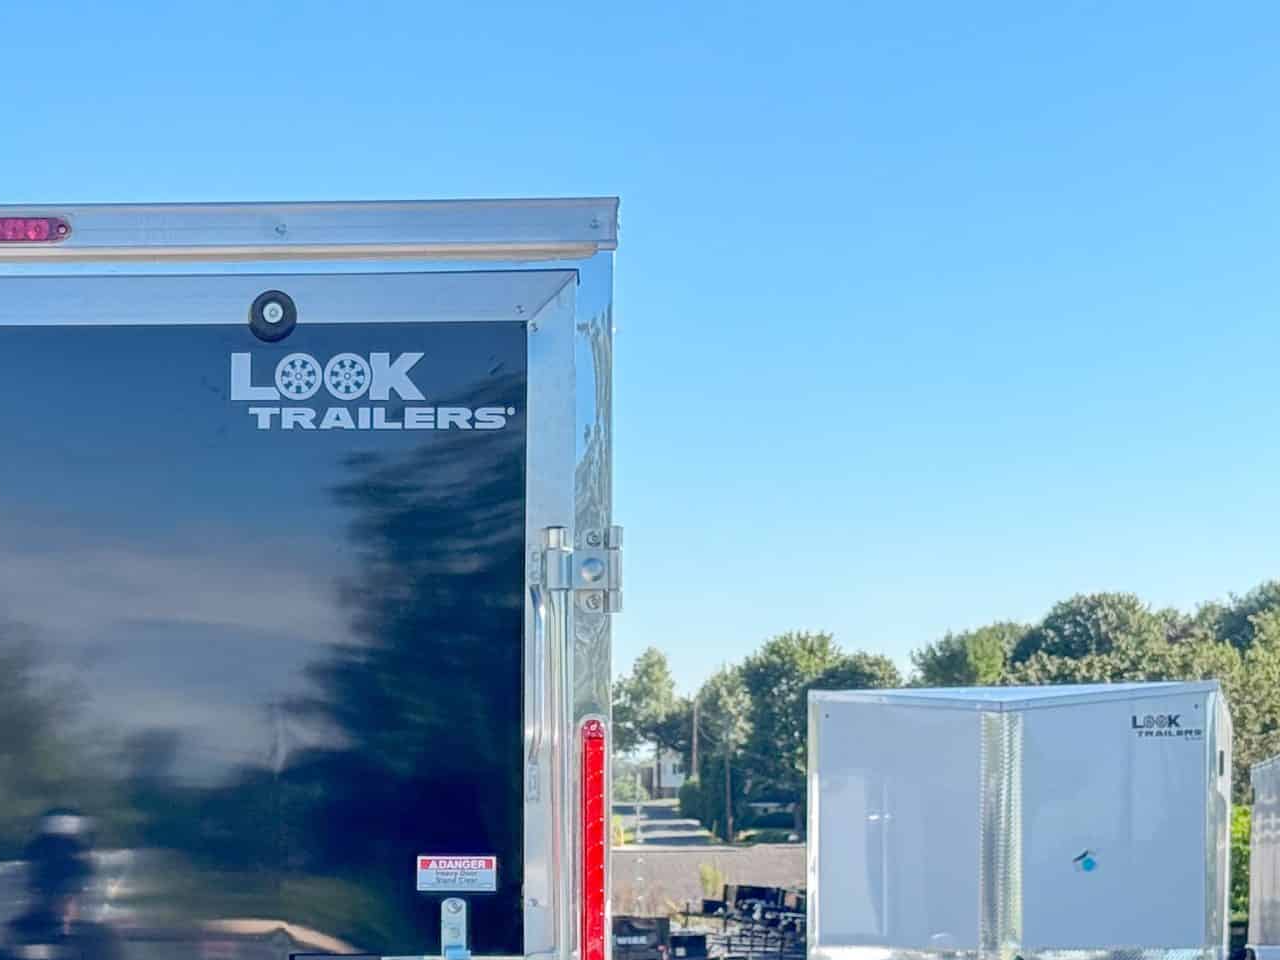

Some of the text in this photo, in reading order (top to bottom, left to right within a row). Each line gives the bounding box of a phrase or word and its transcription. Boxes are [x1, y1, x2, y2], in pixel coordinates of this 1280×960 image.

[231, 352, 425, 400] LOOK
[248, 407, 507, 430] TRAILERS
[1131, 714, 1181, 729] LOOK
[1136, 729, 1202, 737] TRAILERS
[438, 859, 486, 870] DANGER
